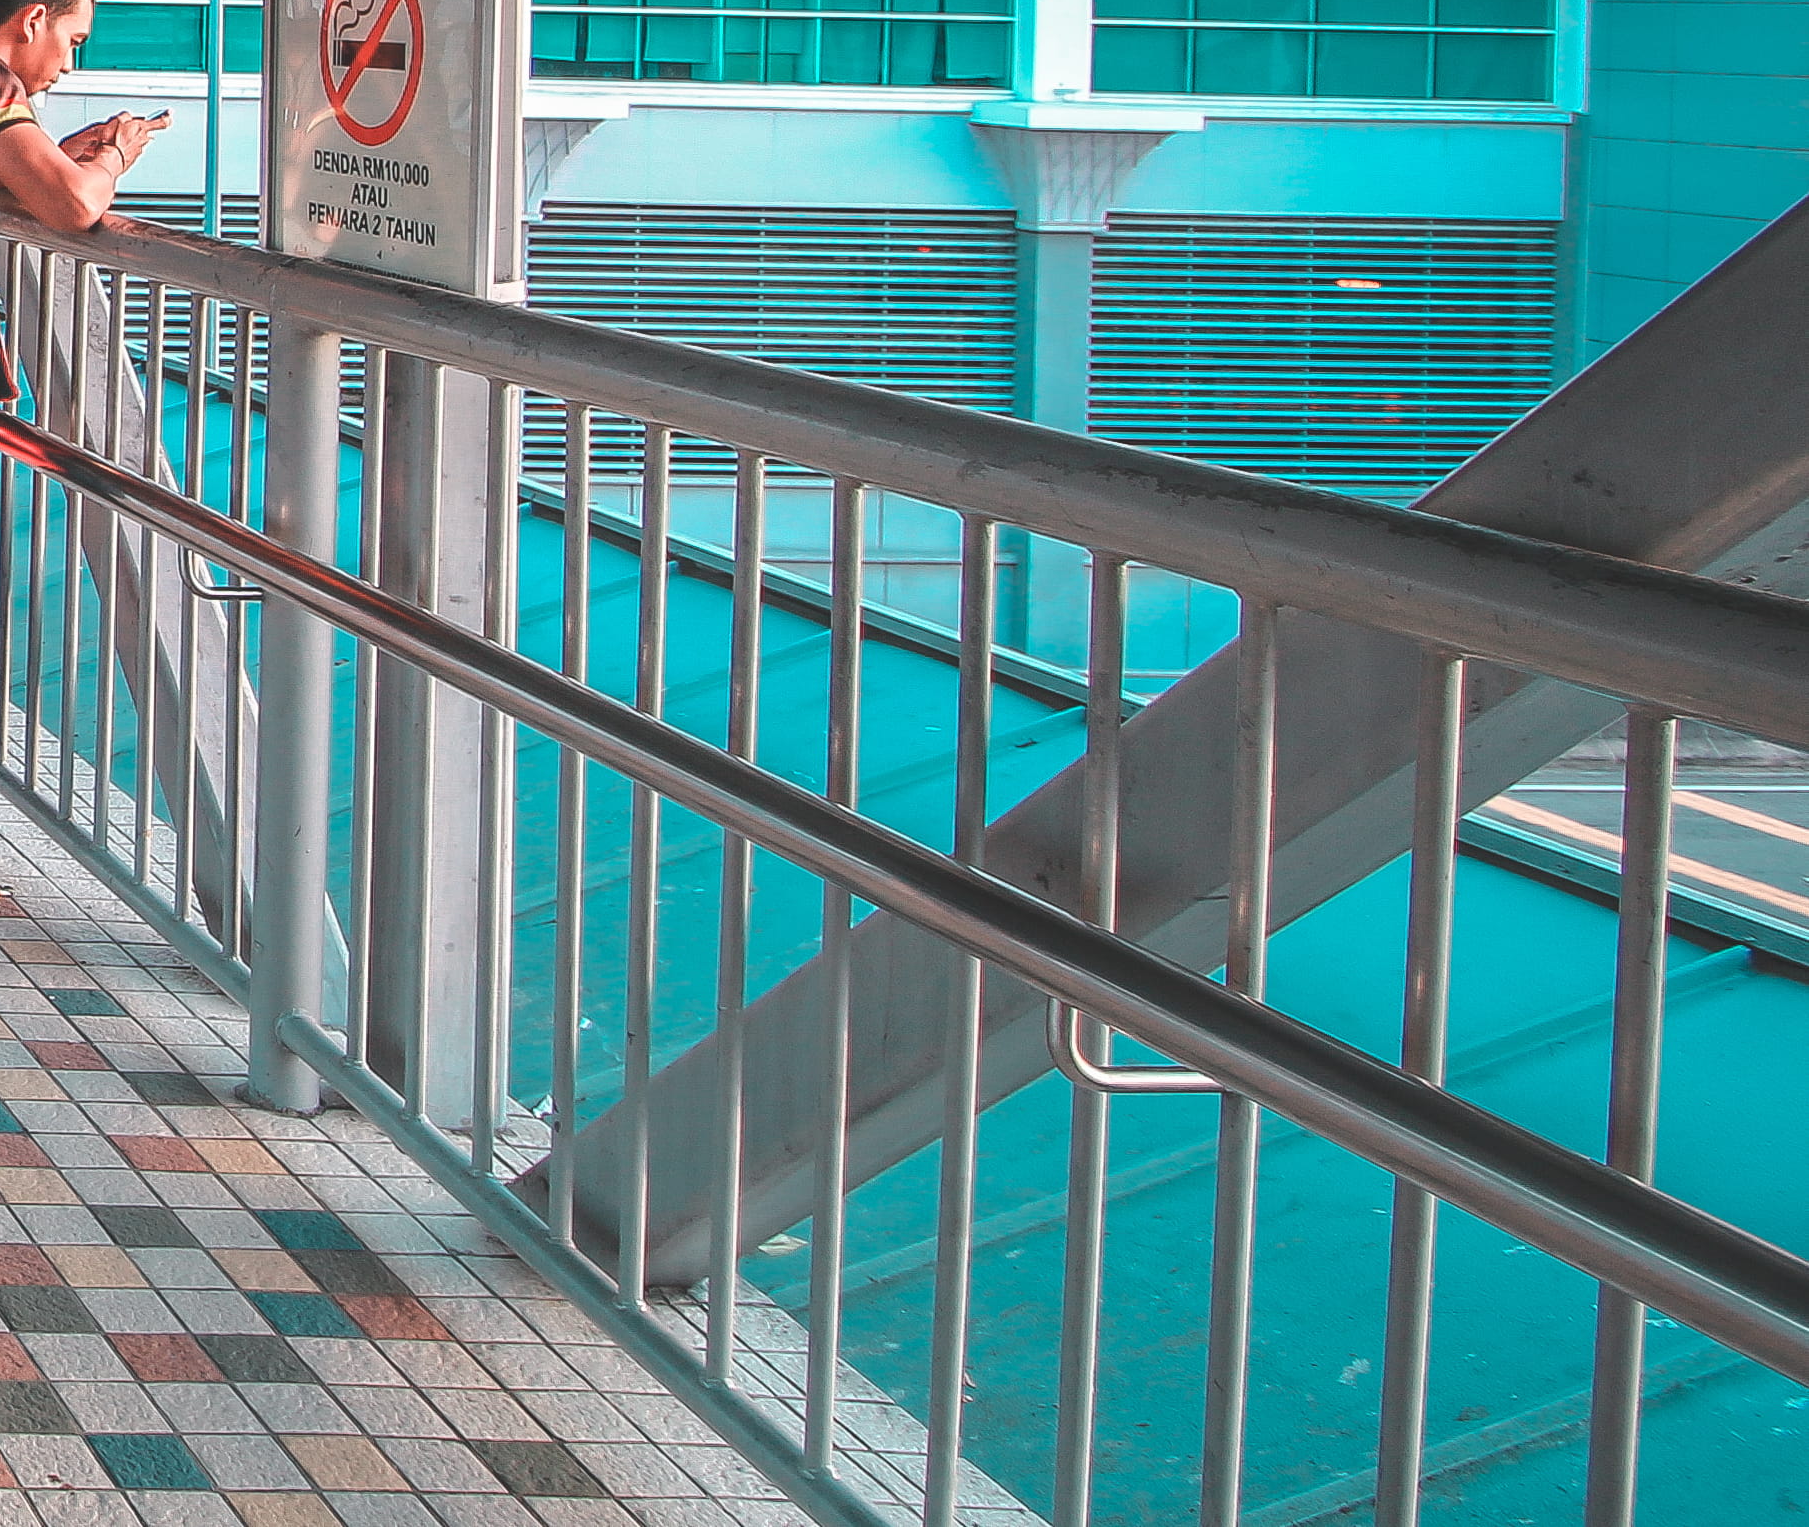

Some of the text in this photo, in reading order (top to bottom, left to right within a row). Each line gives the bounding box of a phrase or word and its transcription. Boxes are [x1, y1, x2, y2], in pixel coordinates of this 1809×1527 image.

[314, 150, 429, 187] DENDA RM10,000
[351, 186, 388, 209] ATAU
[308, 202, 435, 247] PENJARA 2 TAHUN
